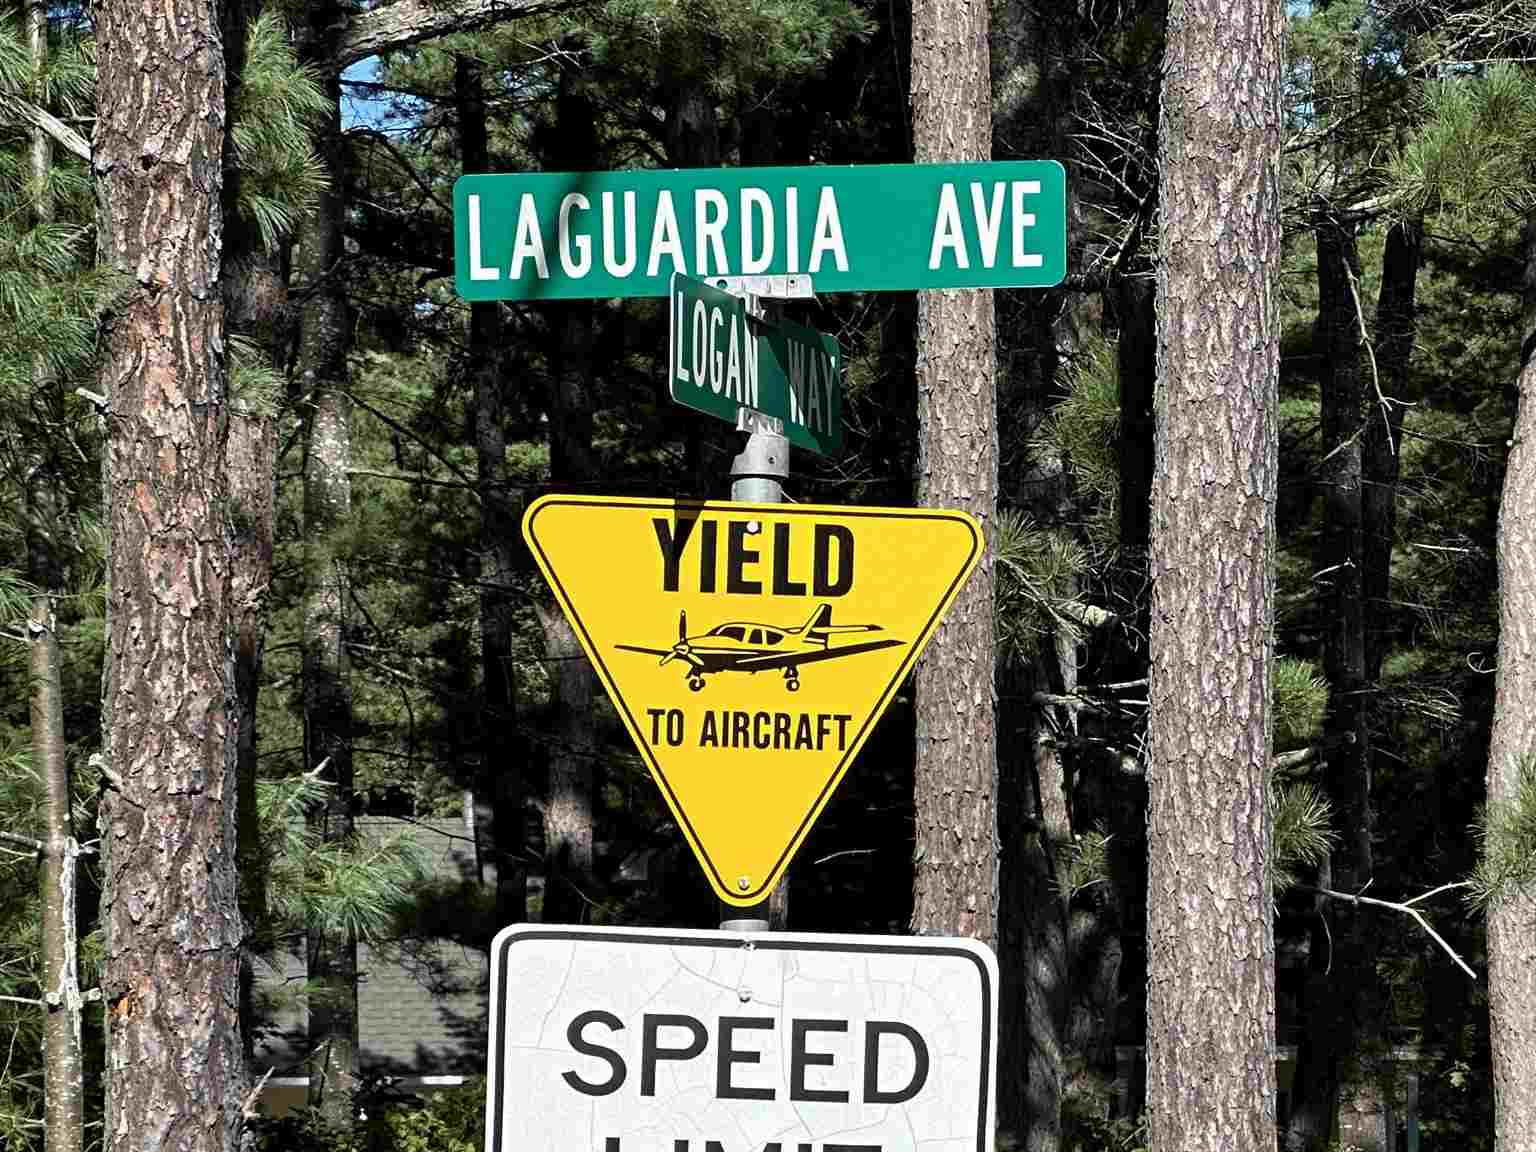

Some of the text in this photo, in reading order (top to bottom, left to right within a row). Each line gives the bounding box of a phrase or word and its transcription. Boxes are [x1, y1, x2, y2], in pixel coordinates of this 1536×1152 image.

[468, 180, 1044, 281] LAGUARDIA AVE
[676, 291, 836, 437] LOGAN WAY
[652, 518, 855, 597] YIELD
[647, 708, 852, 751] TO AIRCRAFT
[561, 1010, 930, 1104] SPEED
